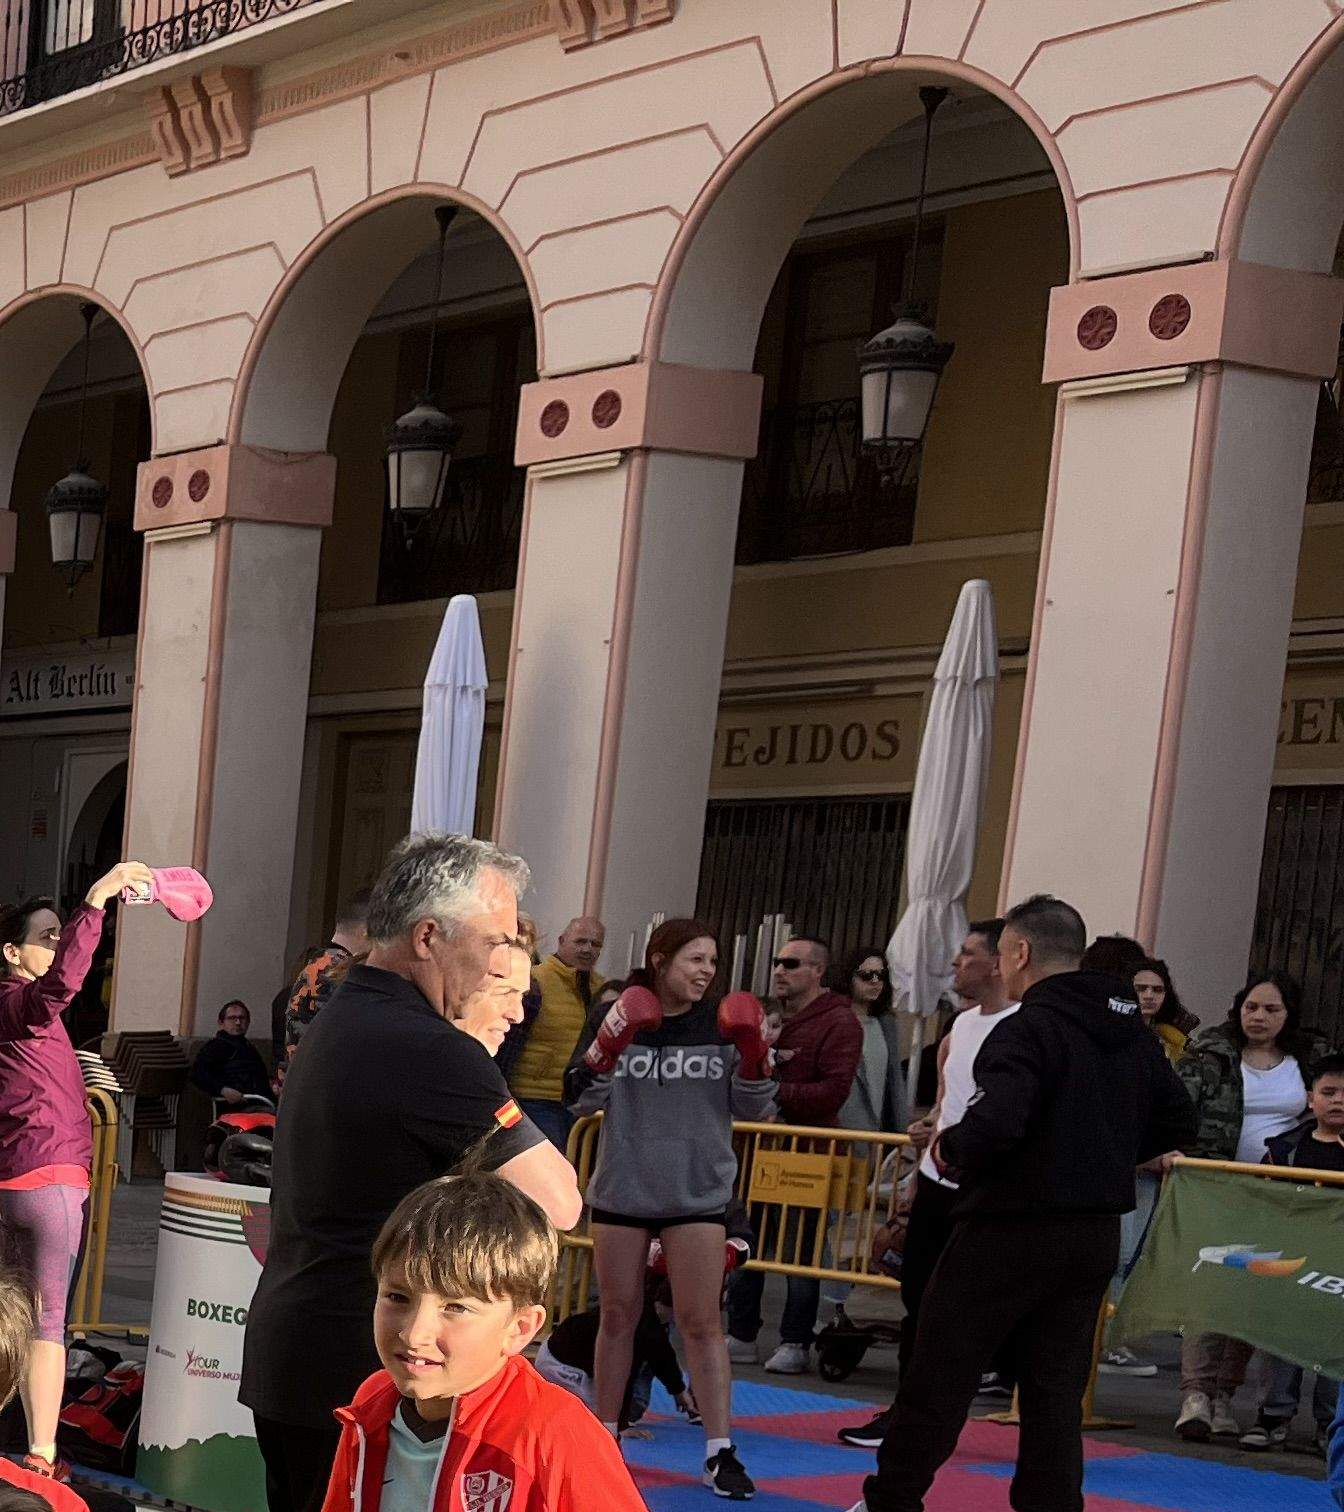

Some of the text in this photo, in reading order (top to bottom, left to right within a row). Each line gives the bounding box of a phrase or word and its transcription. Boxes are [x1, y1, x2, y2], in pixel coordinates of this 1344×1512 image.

[6, 663, 117, 704] Alt Berlin
[714, 719, 901, 767] EJIDOS
[614, 1050, 724, 1080] adidas
[1297, 1271, 1344, 1298] IB
